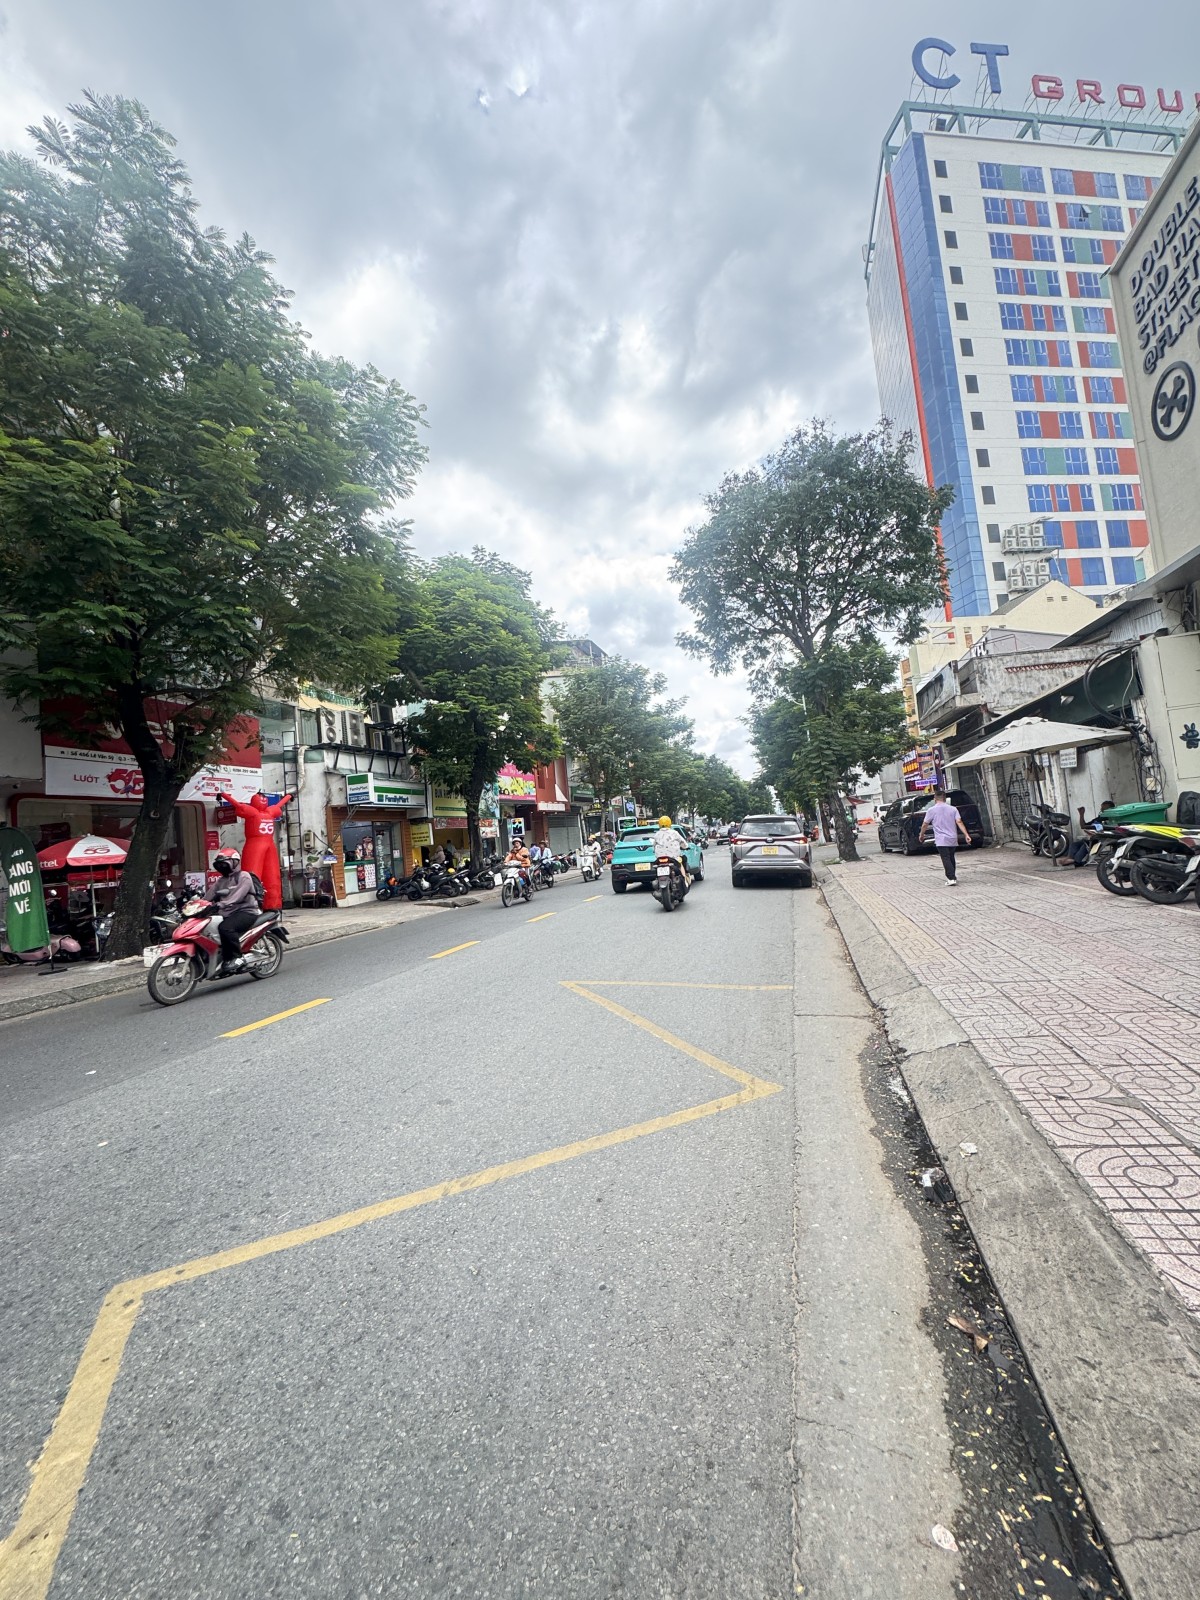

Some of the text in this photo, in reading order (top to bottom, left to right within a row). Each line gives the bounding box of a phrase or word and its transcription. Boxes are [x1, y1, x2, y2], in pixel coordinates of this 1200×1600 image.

[1031, 75, 1200, 113] GROU
[1130, 176, 1200, 299] DOUBLE
[1133, 207, 1200, 325] BAD HA
[1138, 249, 1200, 350] STREET
[74, 773, 100, 784] LƯỚT
[385, 794, 409, 804] FamilyMart
[258, 822, 275, 835] 5G
